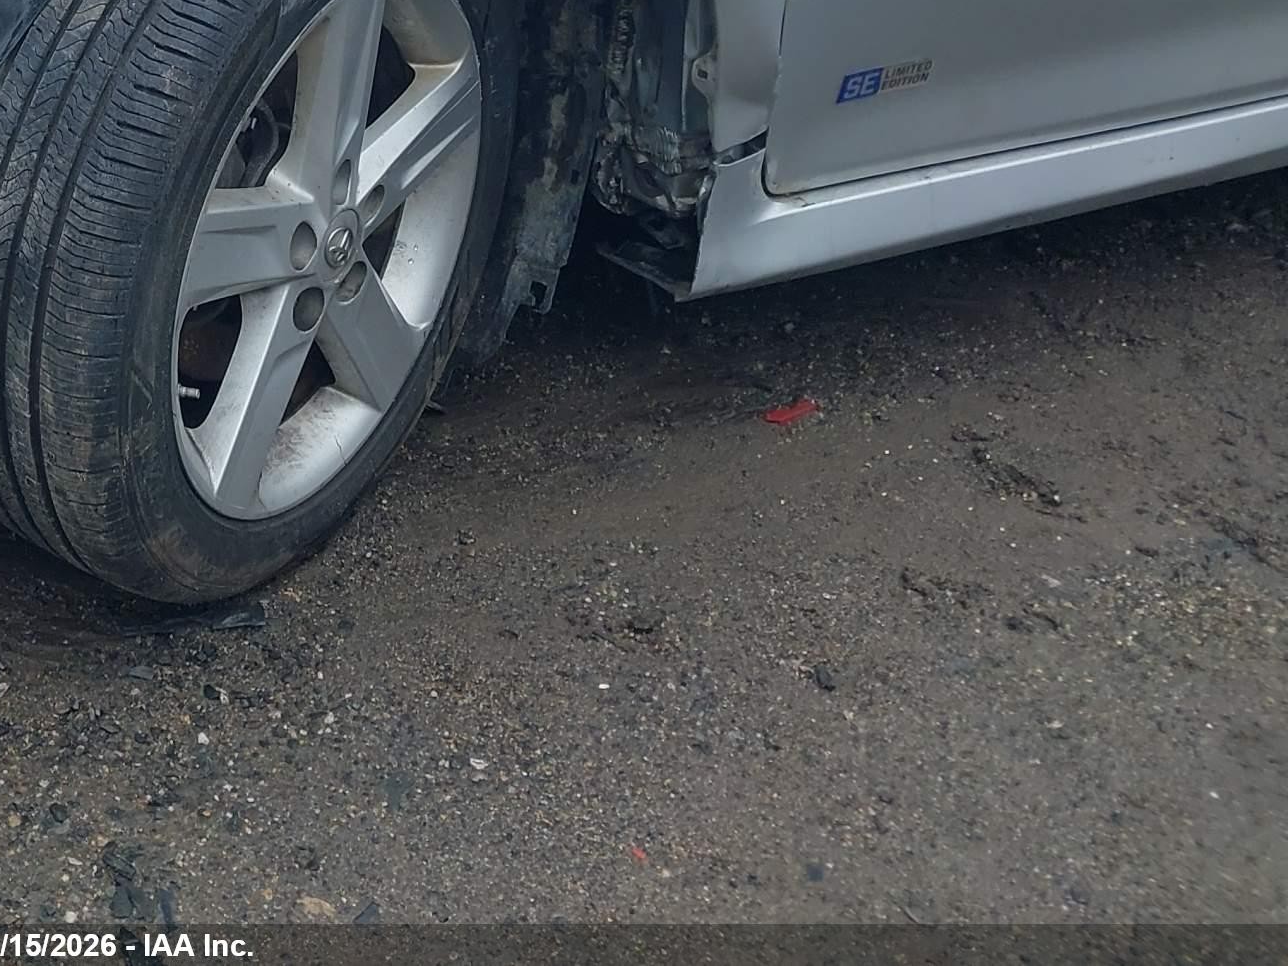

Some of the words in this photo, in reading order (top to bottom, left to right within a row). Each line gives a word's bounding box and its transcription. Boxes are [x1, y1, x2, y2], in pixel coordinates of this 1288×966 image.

[884, 59, 933, 80] LIMITED
[841, 71, 882, 100] SE
[880, 72, 930, 91] EDITION
